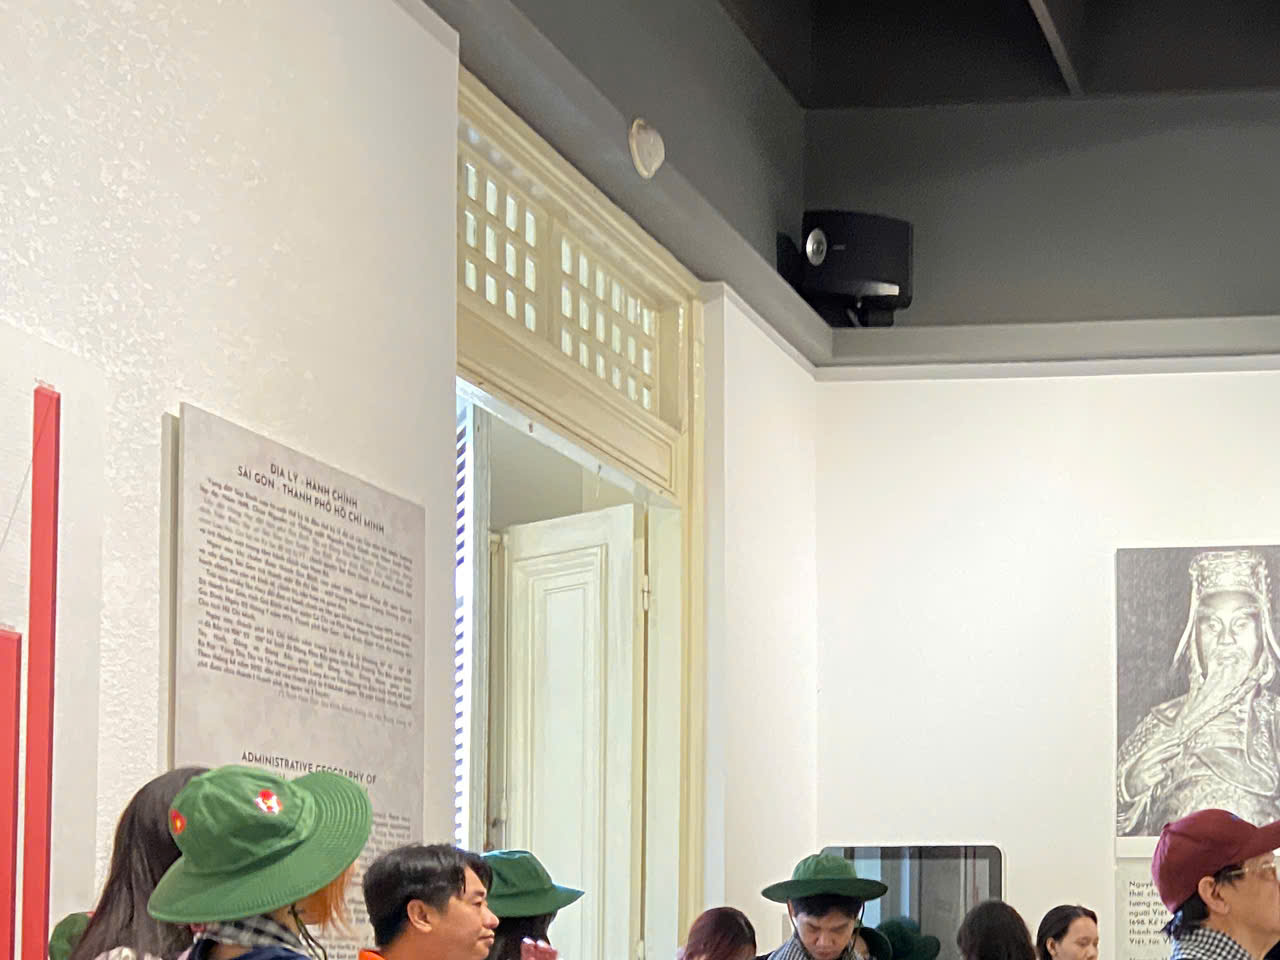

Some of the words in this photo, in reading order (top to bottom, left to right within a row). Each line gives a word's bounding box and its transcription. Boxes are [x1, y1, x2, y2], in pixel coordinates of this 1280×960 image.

[364, 519, 385, 536] MINH
[242, 751, 313, 773] ADMINISTRATIVE
[366, 775, 377, 785] OF
